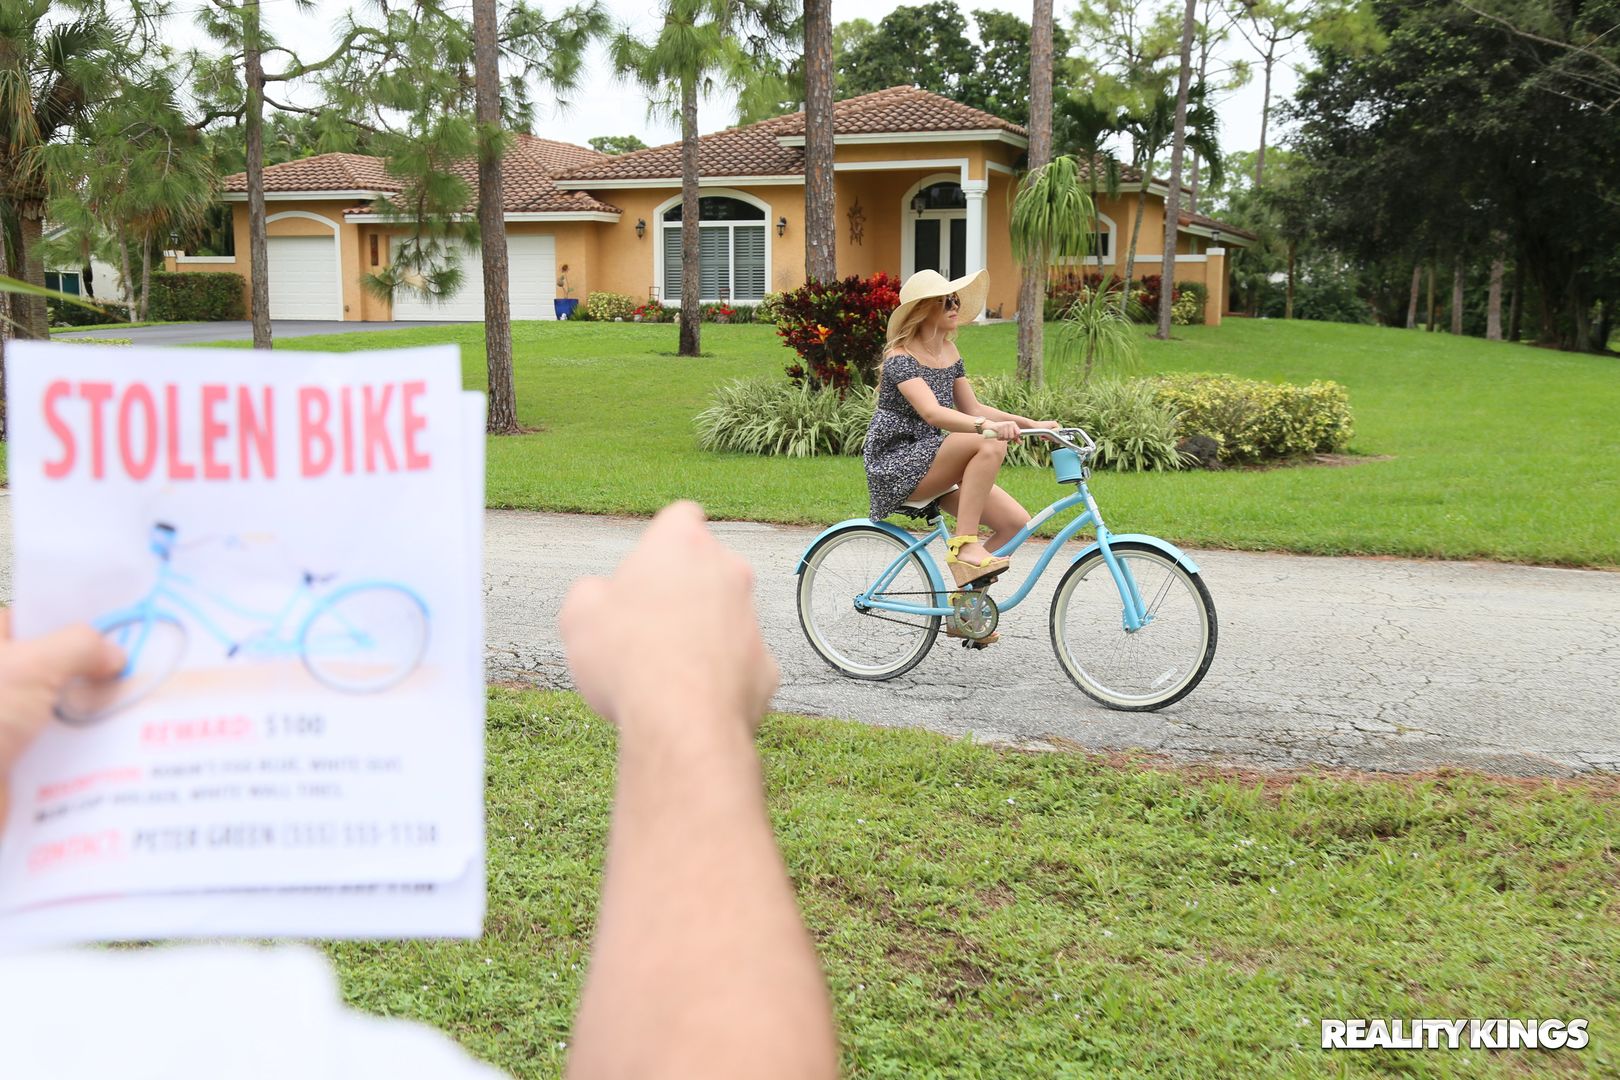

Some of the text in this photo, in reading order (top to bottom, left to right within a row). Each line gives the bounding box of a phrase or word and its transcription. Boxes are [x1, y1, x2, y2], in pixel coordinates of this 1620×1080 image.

[42, 379, 433, 481] STOLEN BIKE
[264, 713, 326, 740] $100
[133, 823, 199, 853] PETER
[206, 821, 275, 851] GREEN
